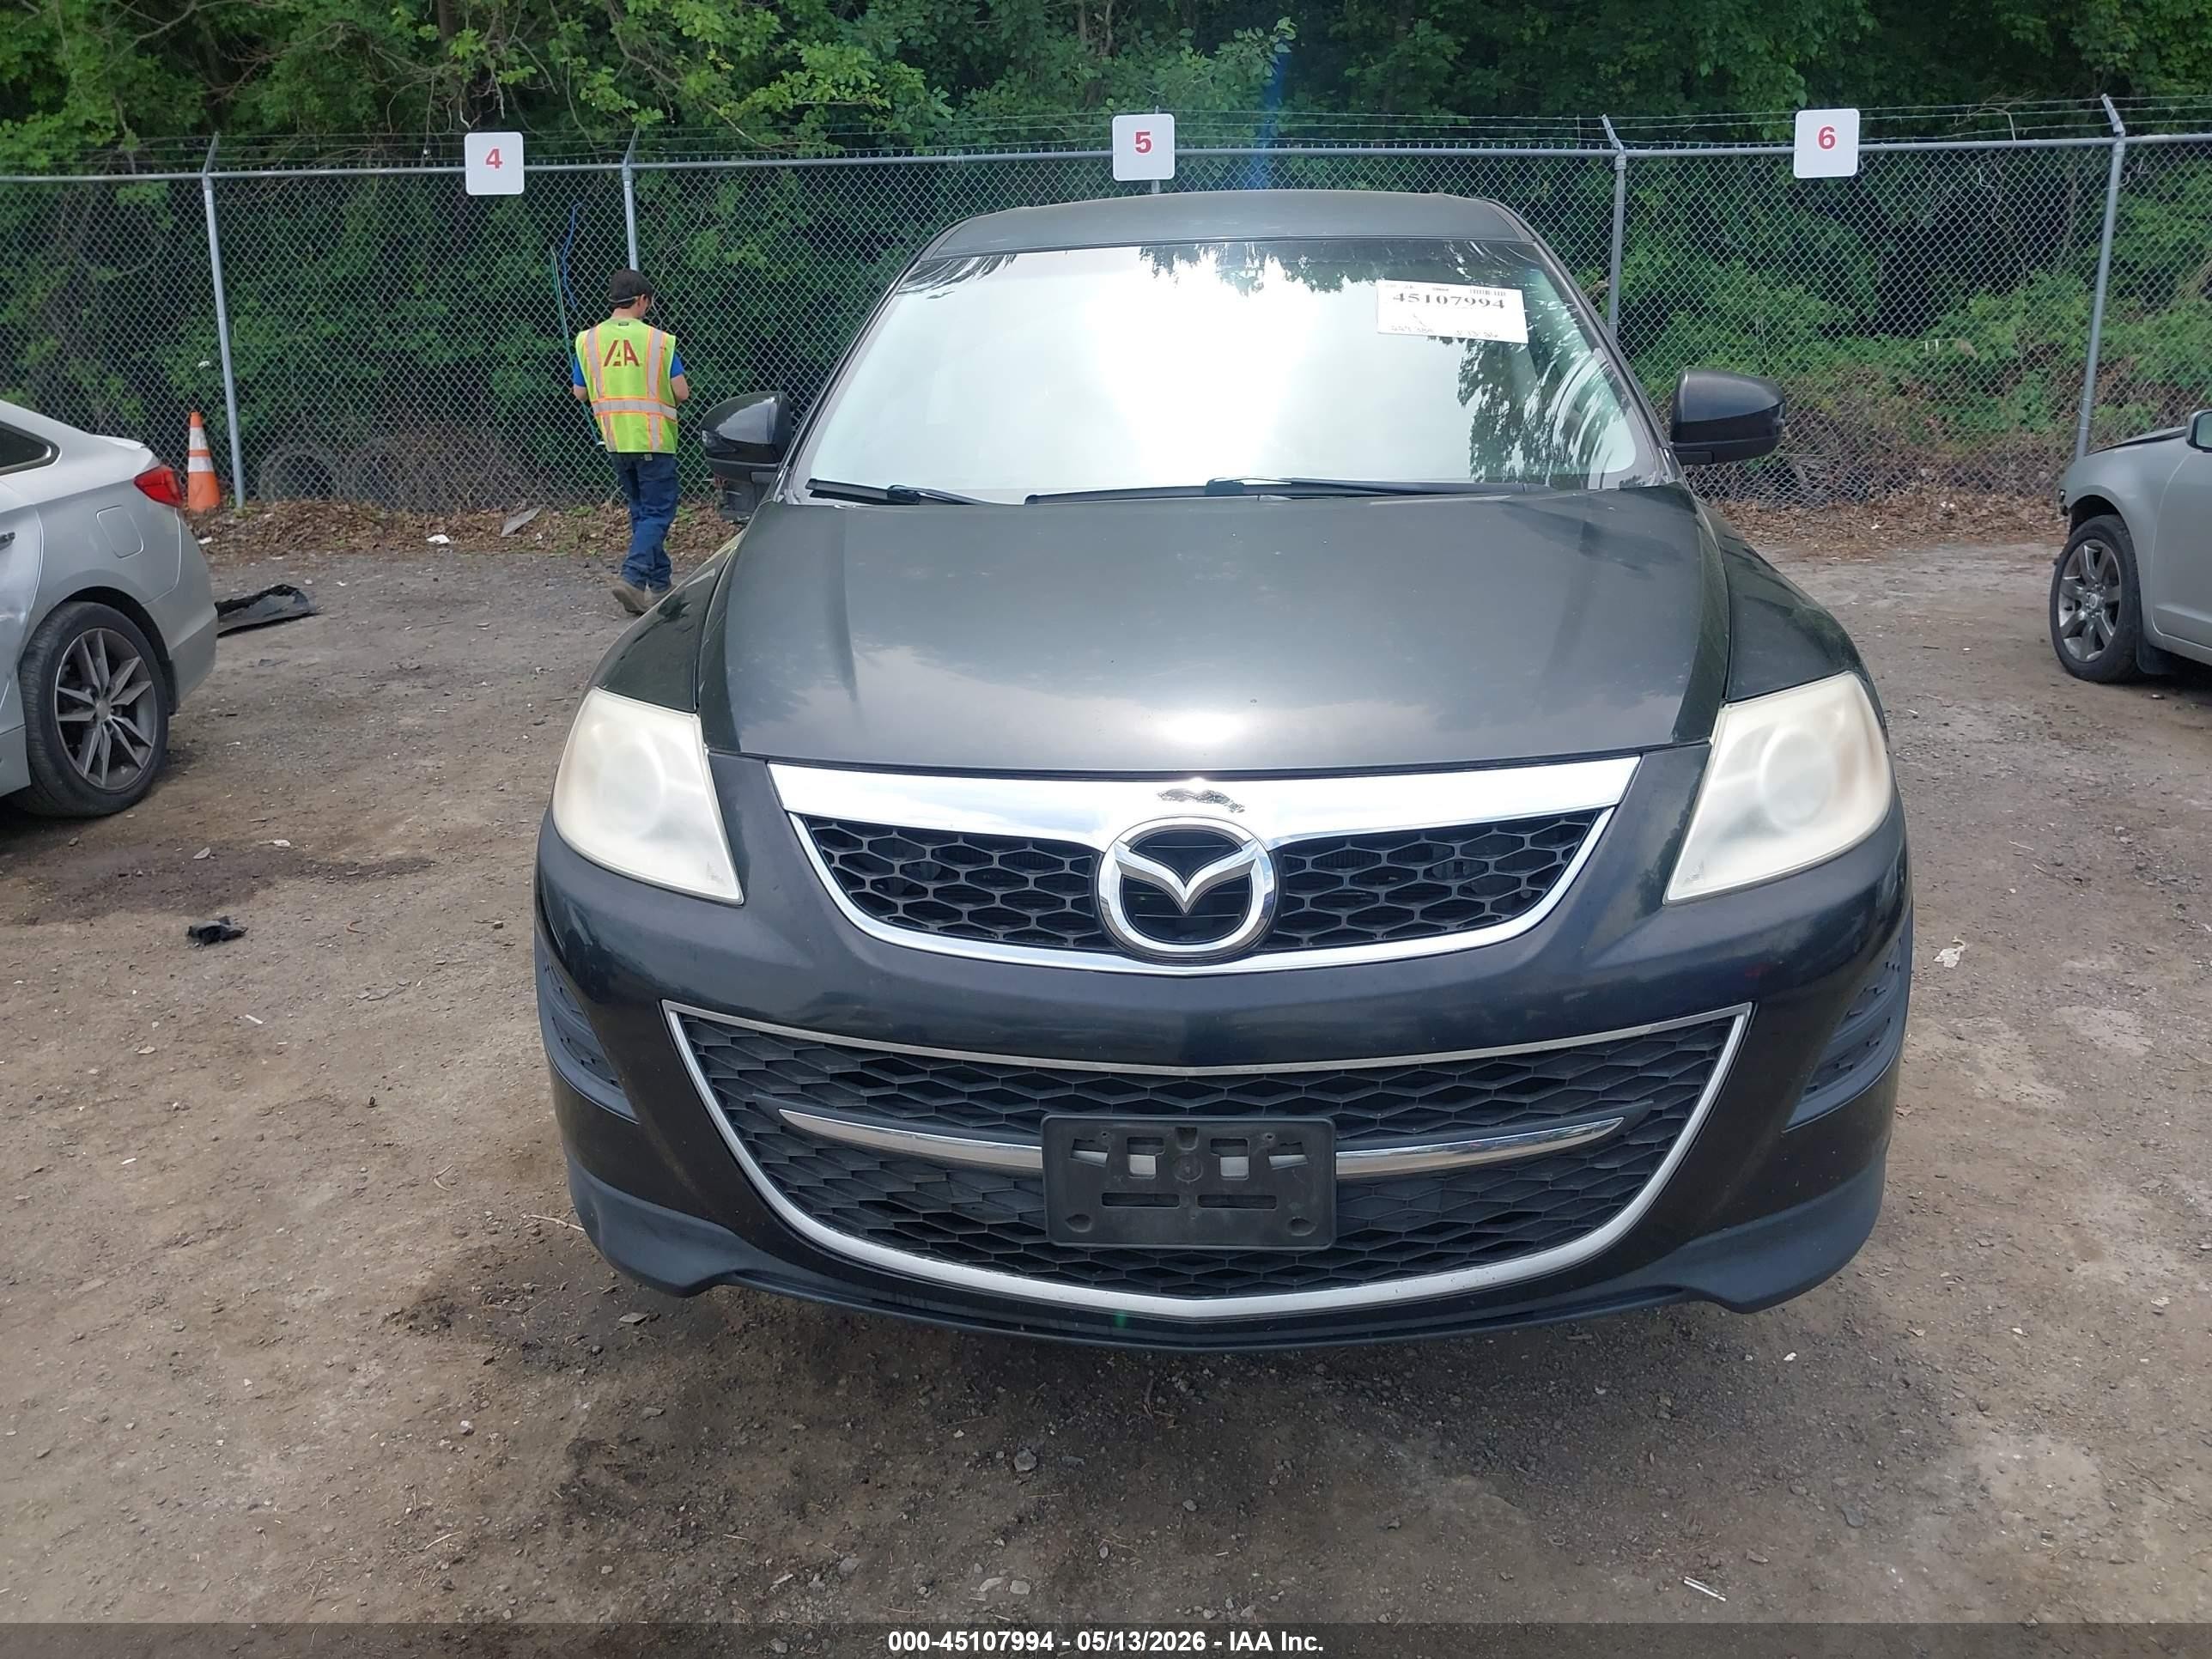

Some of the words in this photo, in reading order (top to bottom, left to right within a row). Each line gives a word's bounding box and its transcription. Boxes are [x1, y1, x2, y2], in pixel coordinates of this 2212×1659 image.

[1135, 131, 1152, 153] 5
[1818, 125, 1836, 149] 6
[485, 148, 503, 169] 4
[1393, 292, 1505, 309] 45107994
